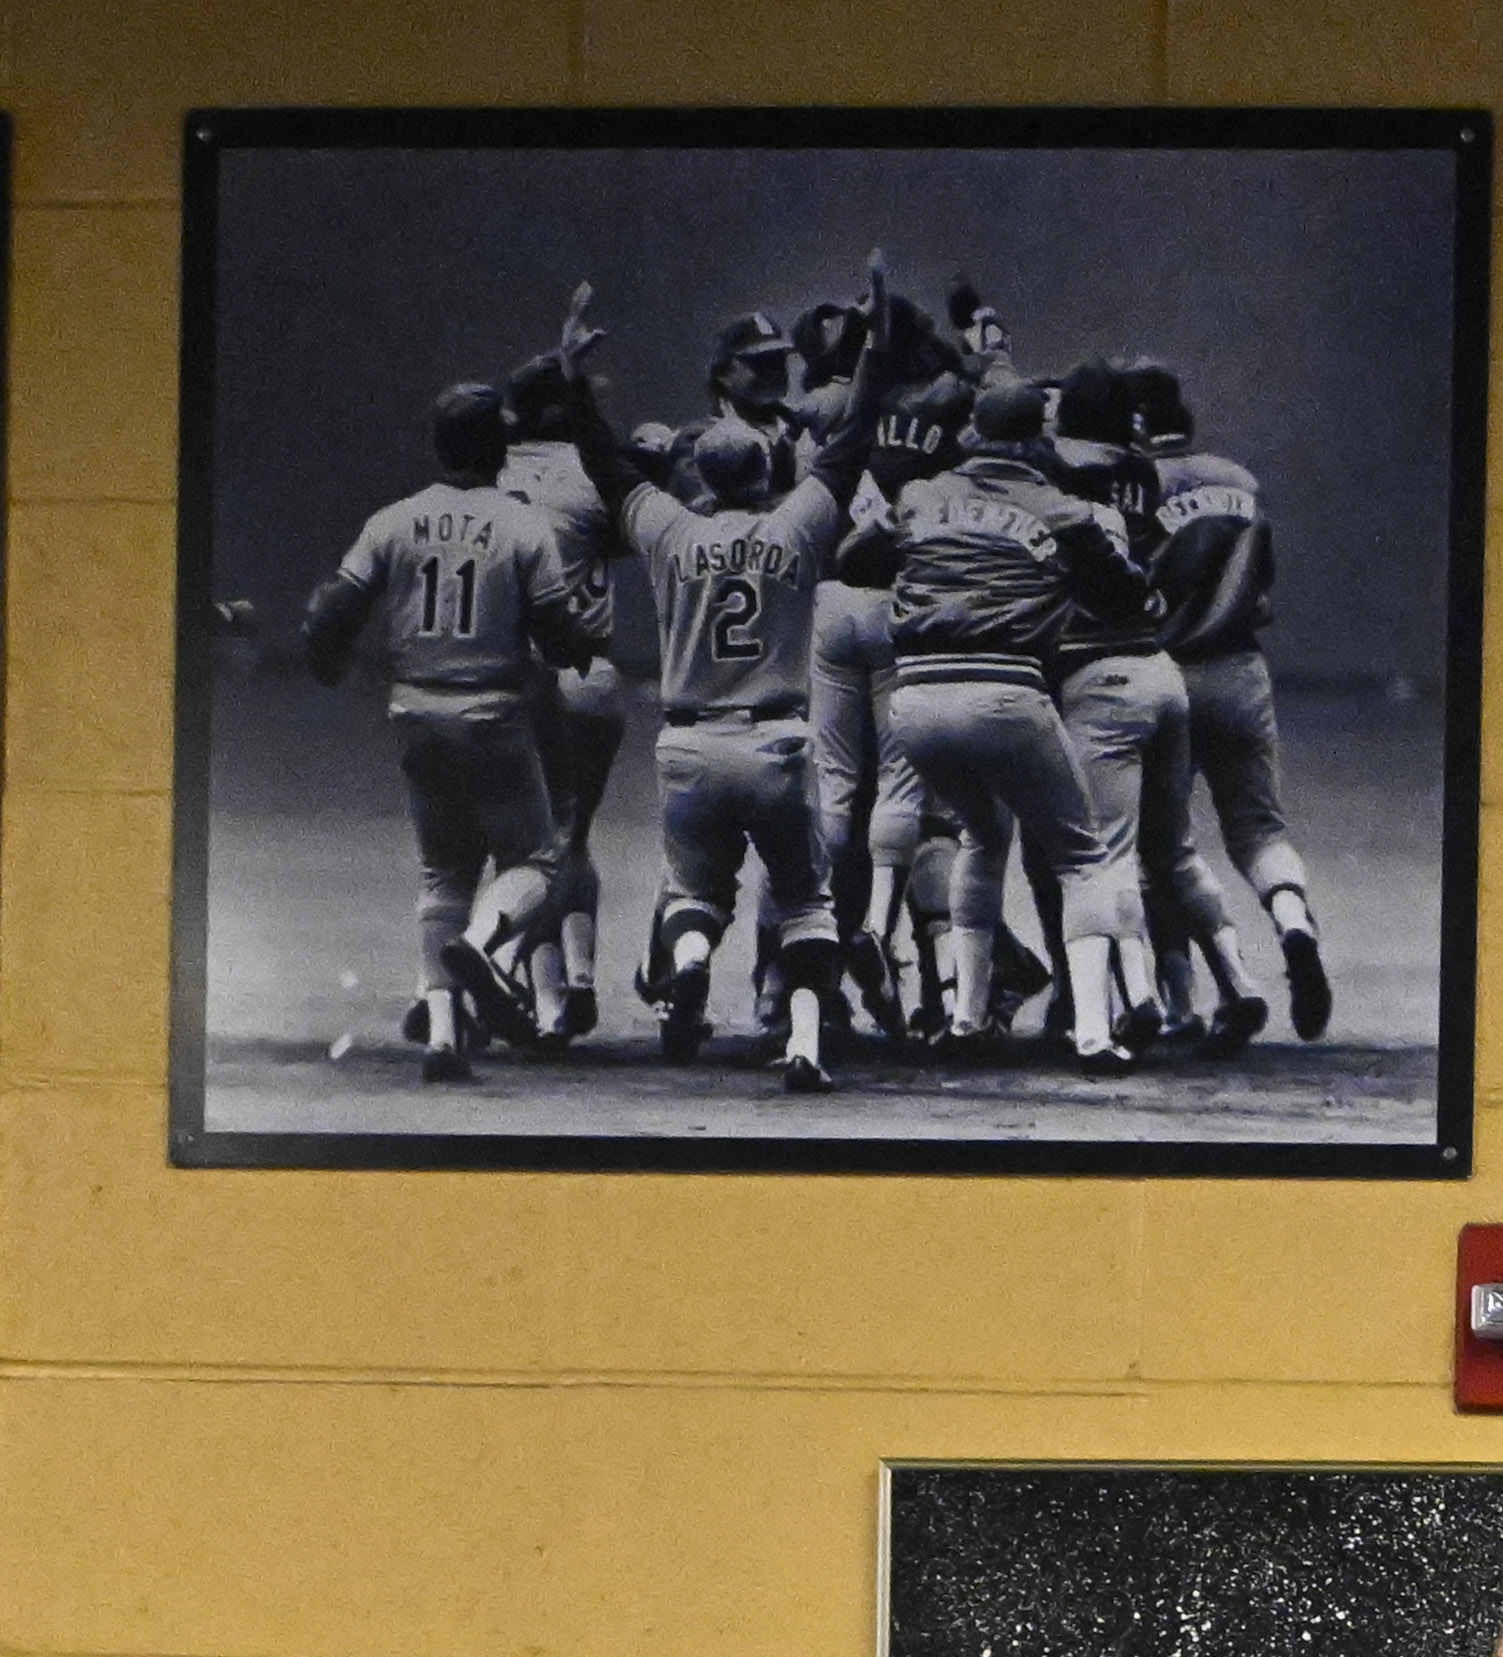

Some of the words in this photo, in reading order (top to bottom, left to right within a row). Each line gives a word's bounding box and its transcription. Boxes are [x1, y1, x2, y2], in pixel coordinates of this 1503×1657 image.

[412, 512, 493, 550] MOTA
[671, 536, 799, 588] LASORDA
[417, 555, 477, 639] 11
[711, 575, 764, 661] 2
